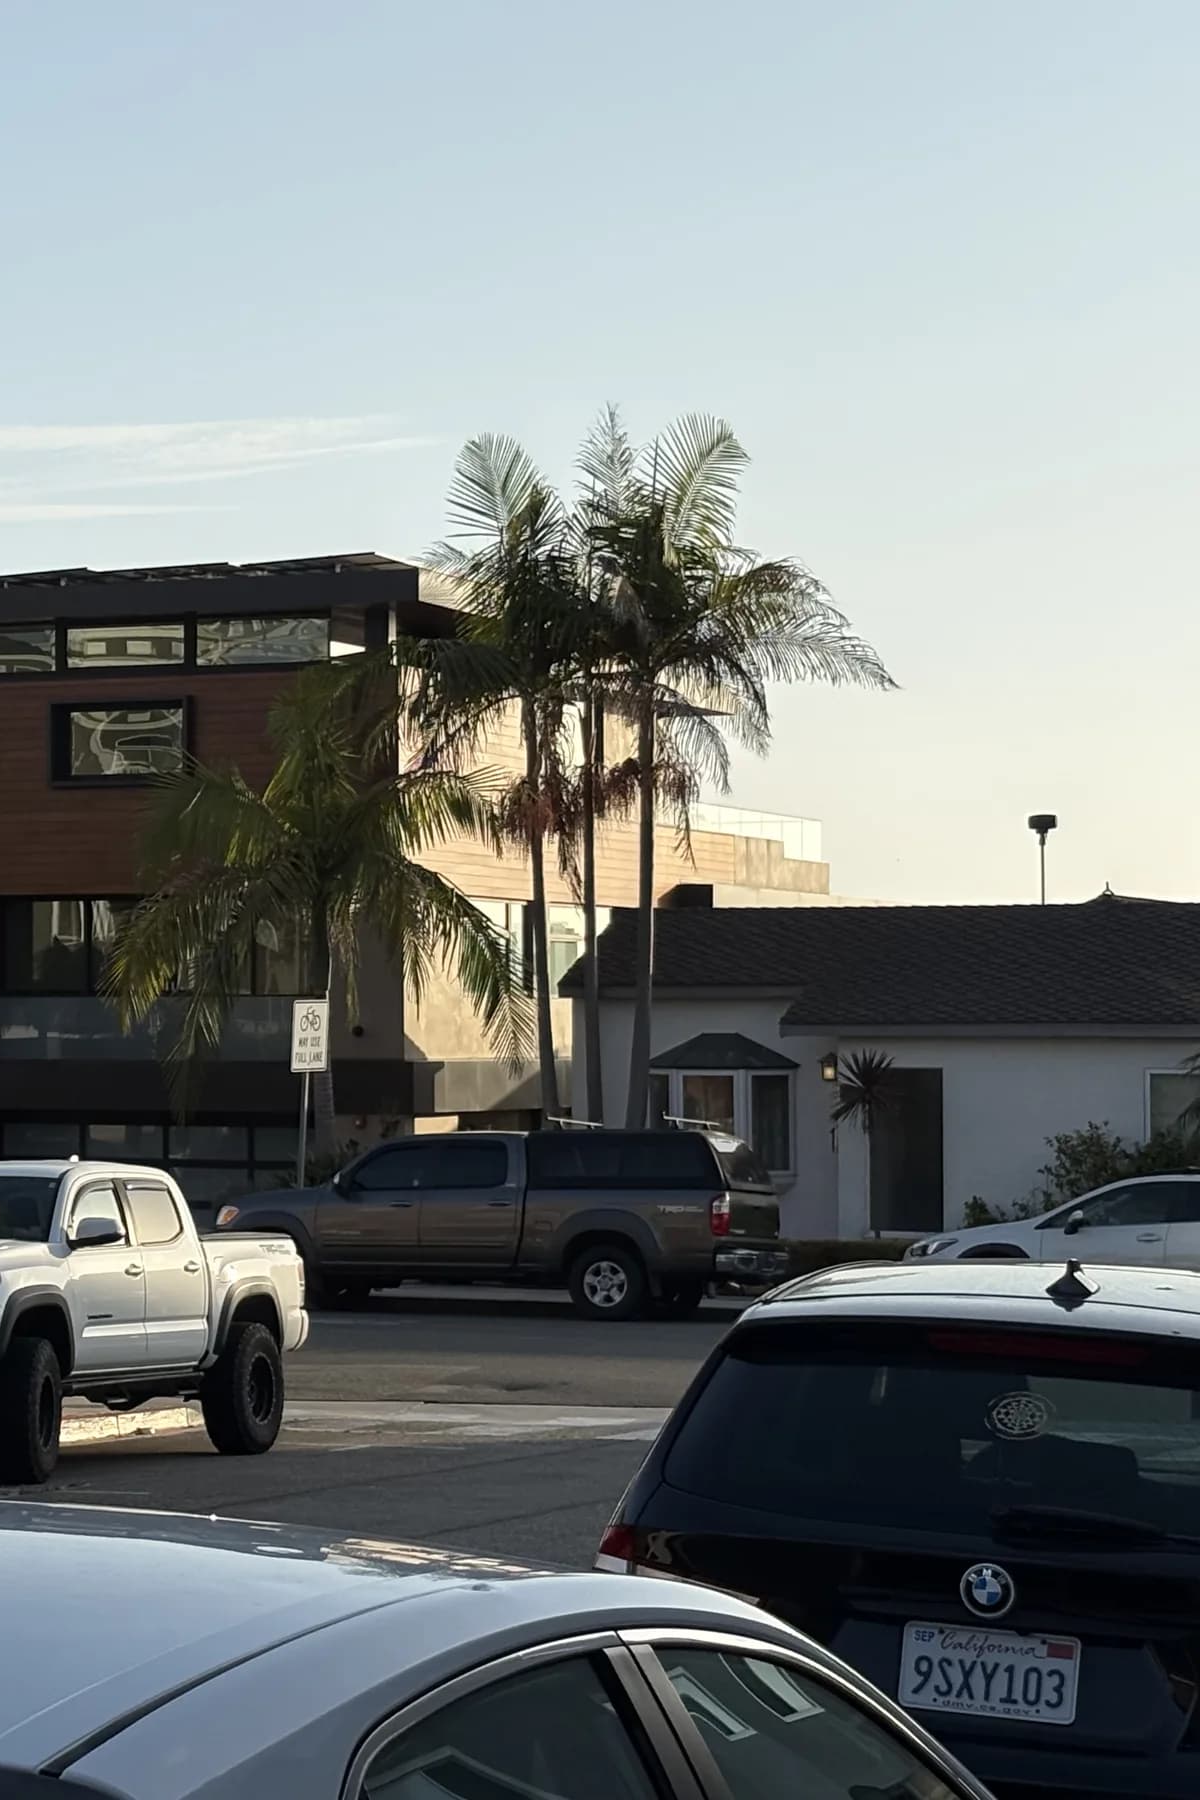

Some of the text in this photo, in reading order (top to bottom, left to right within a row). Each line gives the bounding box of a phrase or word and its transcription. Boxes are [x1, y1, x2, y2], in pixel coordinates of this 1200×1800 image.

[298, 1036, 321, 1048] MAY USE
[295, 1051, 323, 1063] FULL LANE
[657, 1205, 684, 1214] TRD
[967, 1568, 1008, 1584] BMW
[913, 1629, 935, 1643] SEP
[940, 1631, 1047, 1659] California
[911, 1655, 1066, 1709] 9SXY103
